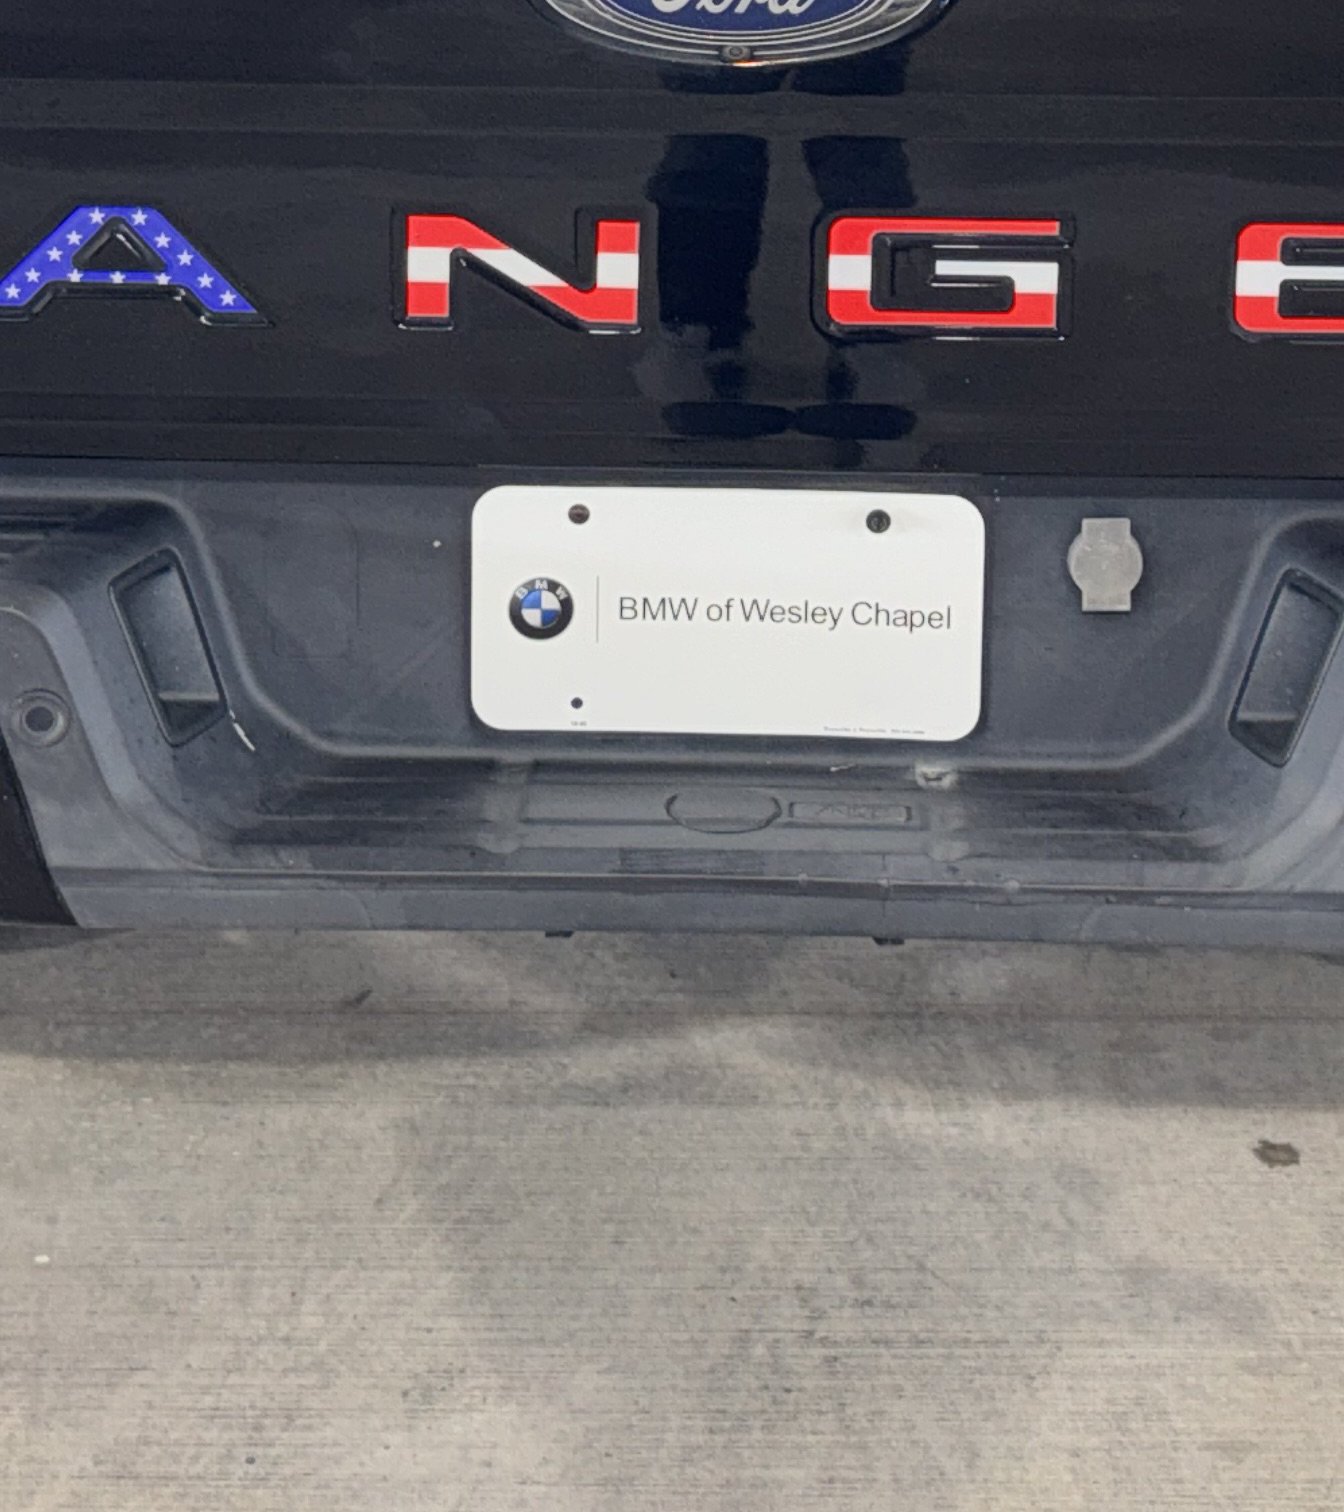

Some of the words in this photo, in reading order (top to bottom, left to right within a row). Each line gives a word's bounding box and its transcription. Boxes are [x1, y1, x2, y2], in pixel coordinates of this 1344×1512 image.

[618, 596, 699, 621] BMW
[706, 597, 735, 622] of
[741, 598, 844, 631] Wesley
[851, 601, 952, 633] Chapel
